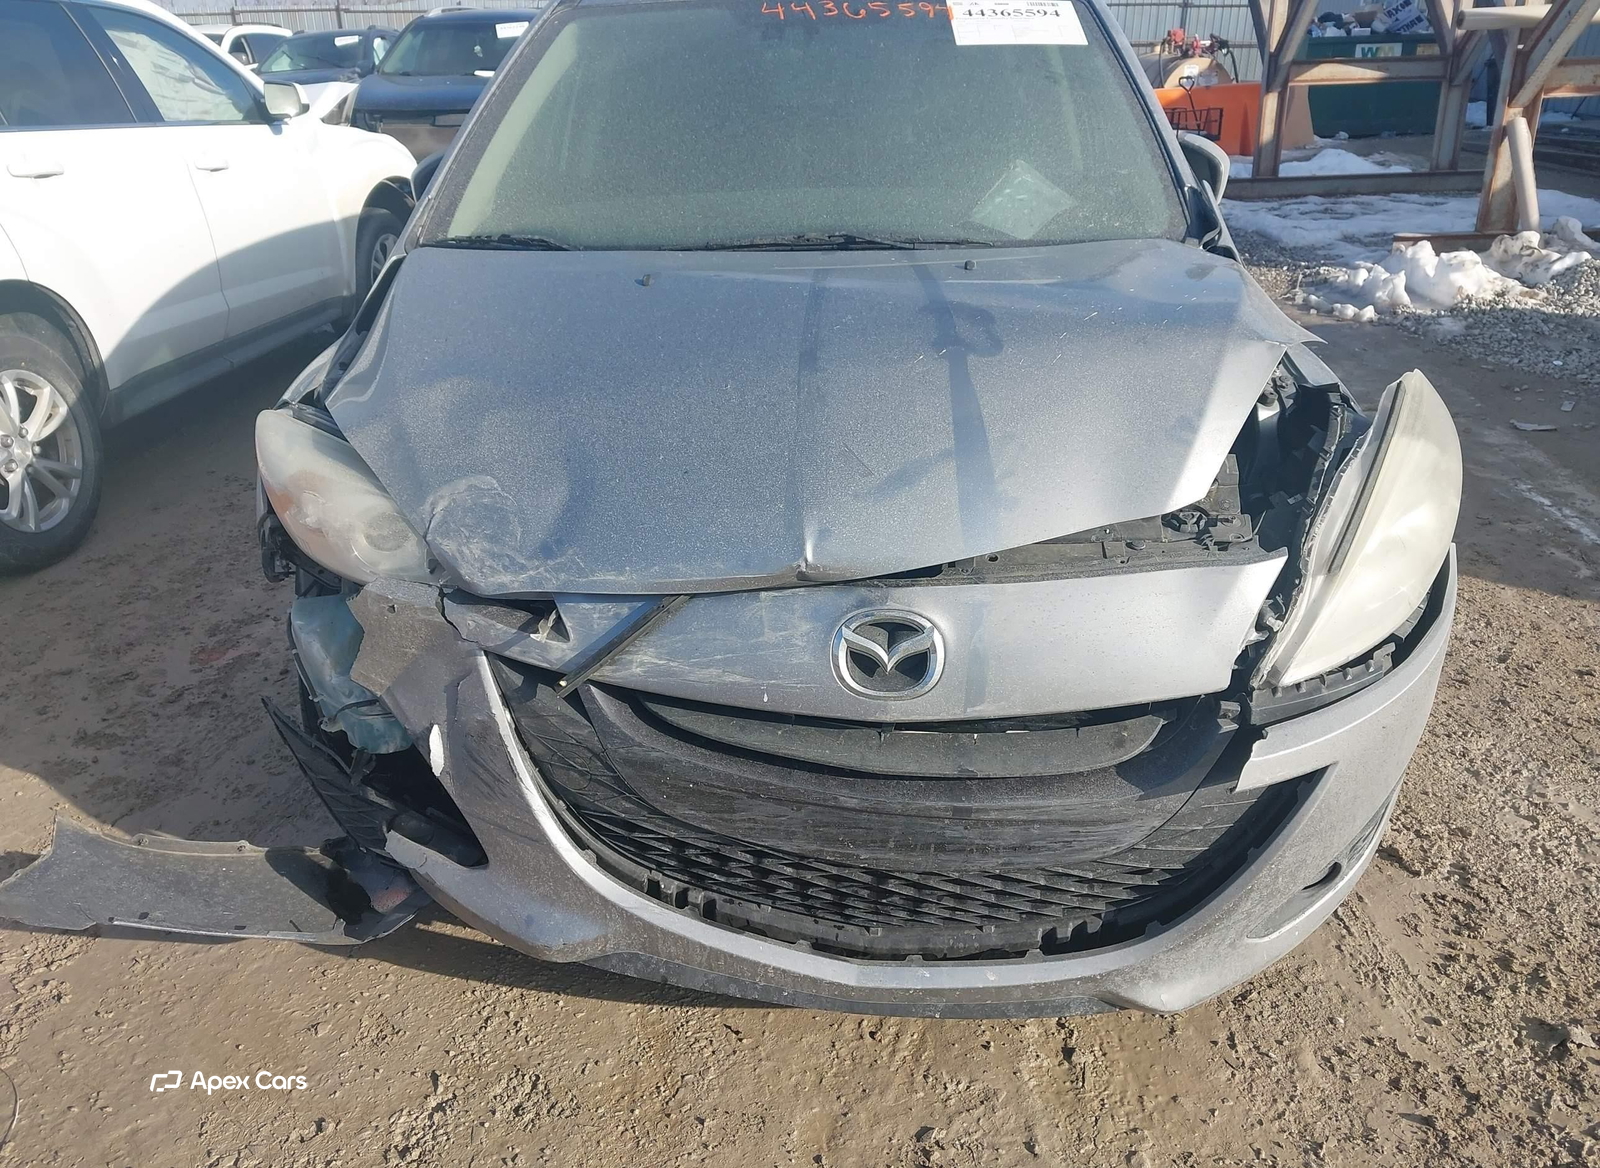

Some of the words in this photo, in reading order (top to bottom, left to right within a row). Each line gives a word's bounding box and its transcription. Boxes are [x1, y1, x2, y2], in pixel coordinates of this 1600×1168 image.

[761, 0, 954, 20] 44365594
[962, 8, 1061, 18] 44365594
[1360, 46, 1396, 58] WM
